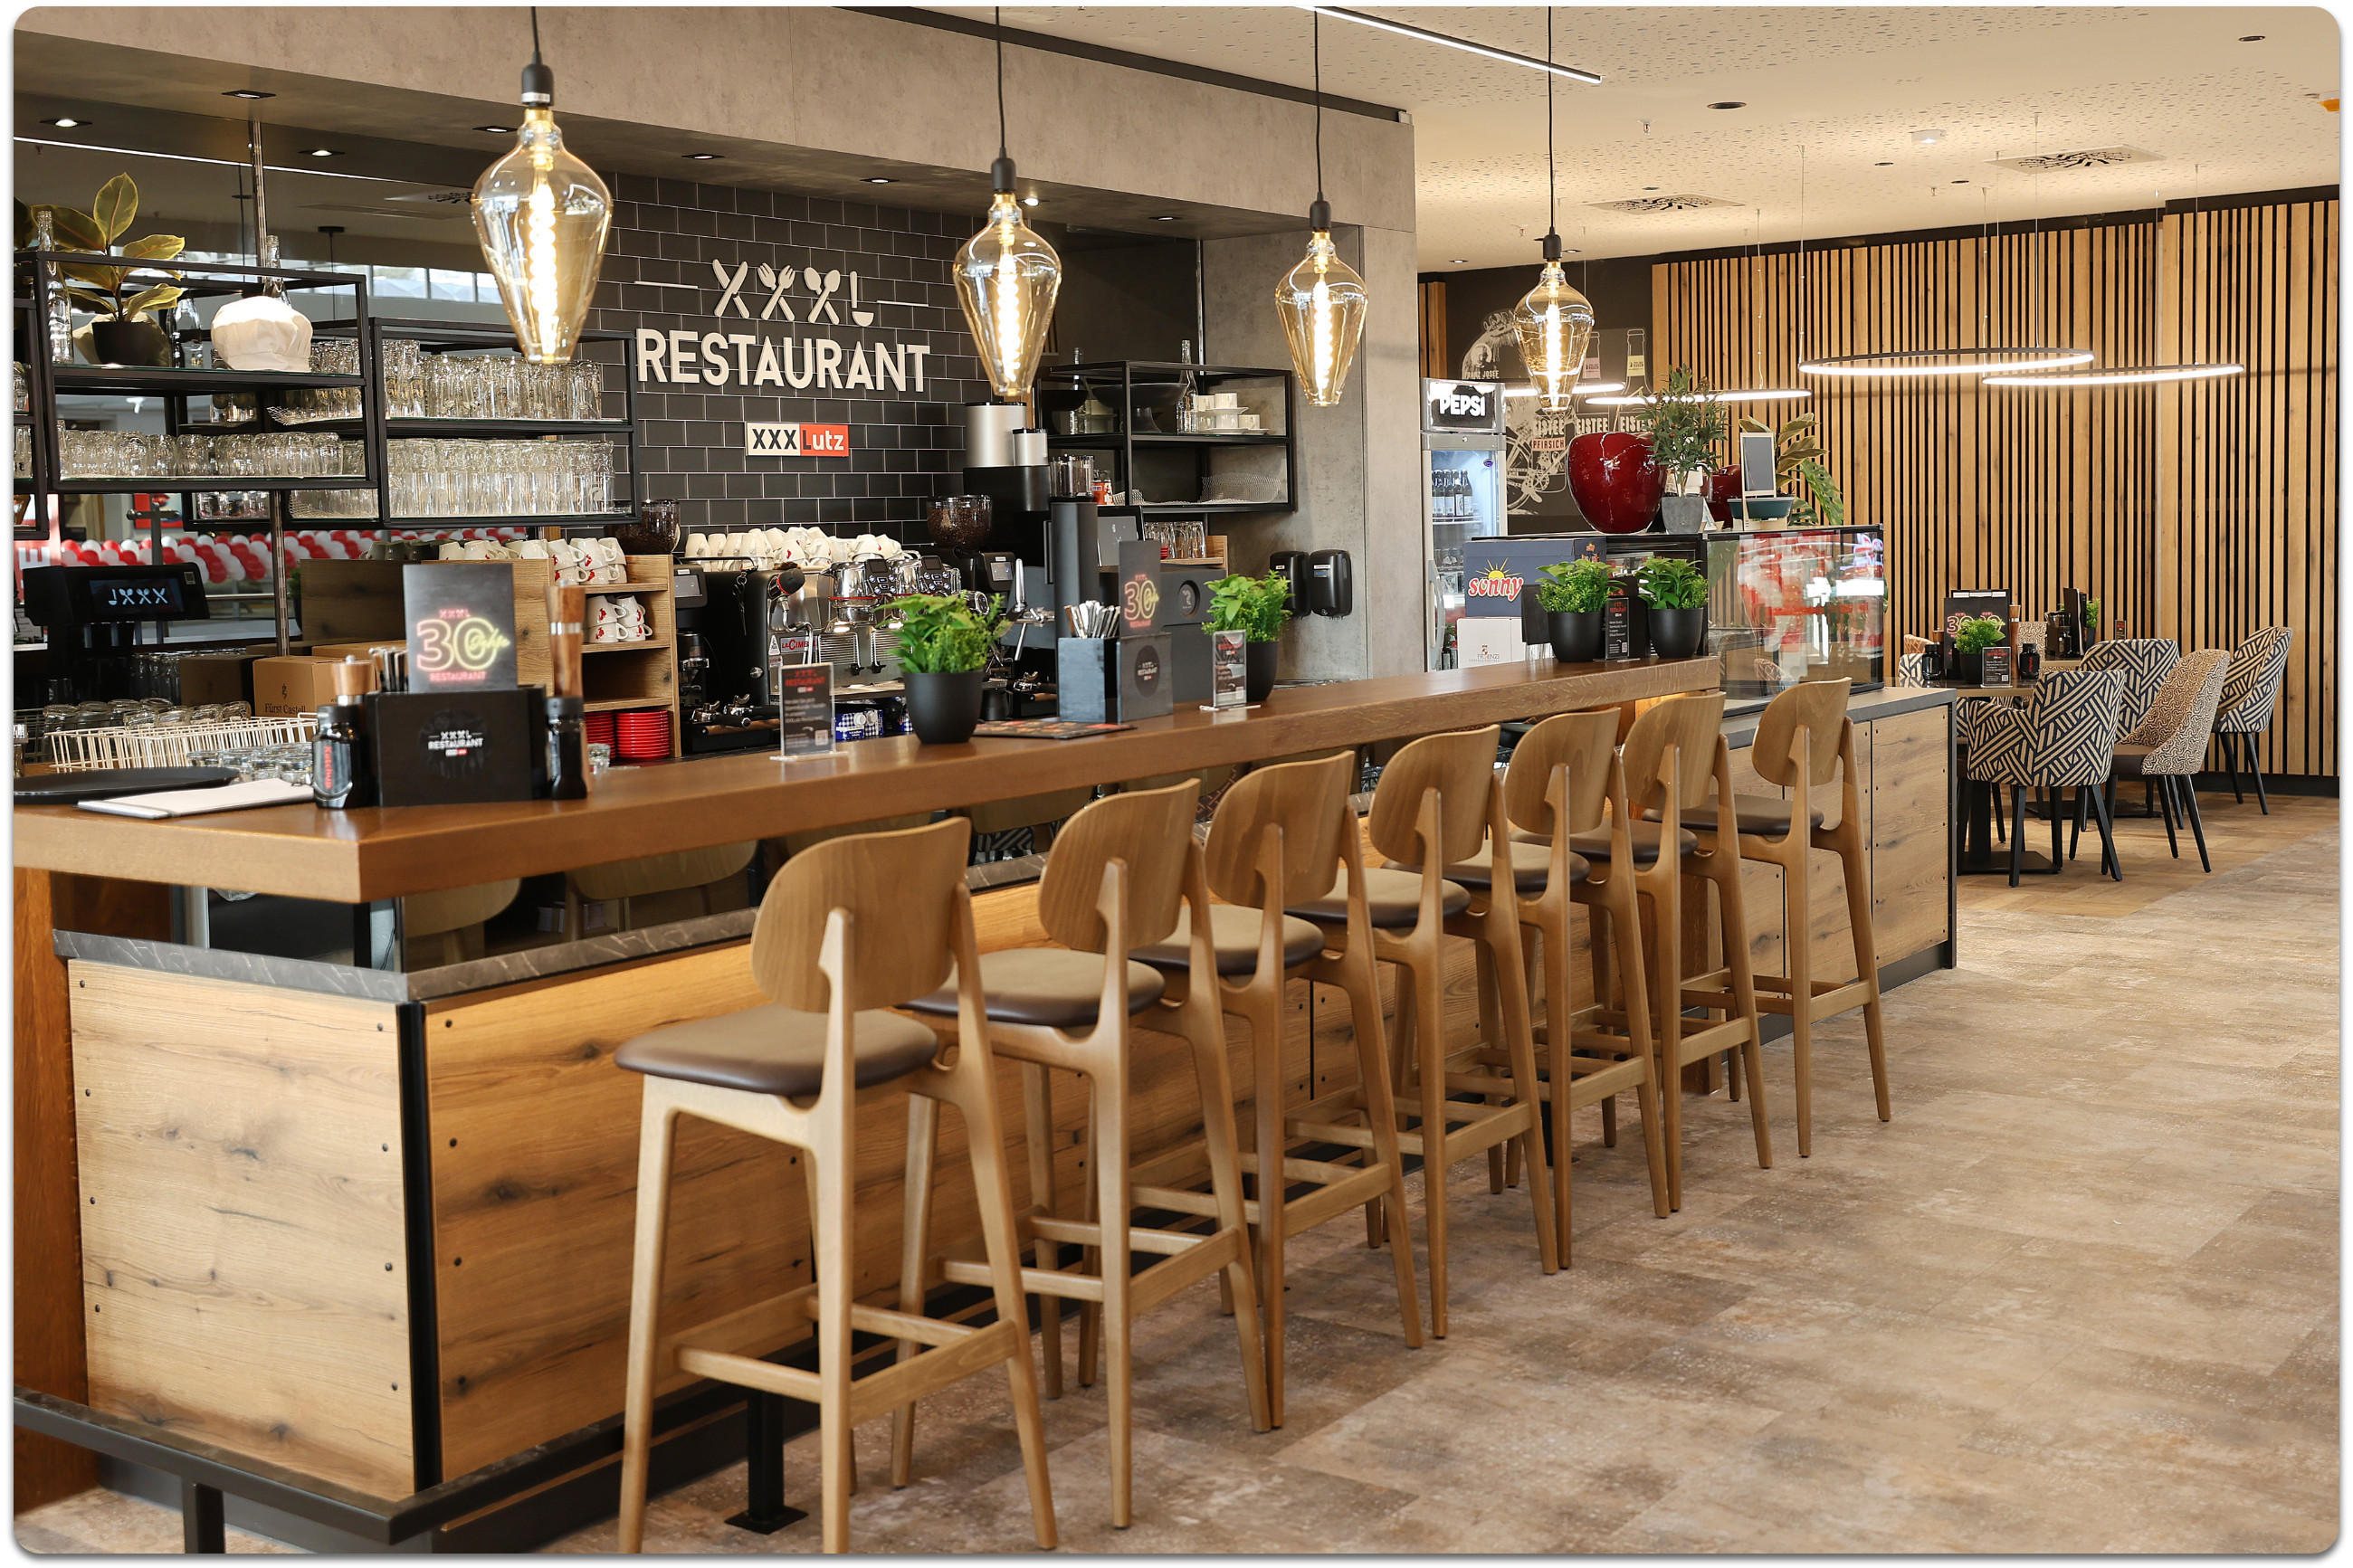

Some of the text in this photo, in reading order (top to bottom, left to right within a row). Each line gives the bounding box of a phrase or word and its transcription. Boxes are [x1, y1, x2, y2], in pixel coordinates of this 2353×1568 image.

[636, 328, 930, 393] RESTAURANT
[1439, 394, 1486, 417] PEPSI
[1577, 417, 1609, 433] EISTEE
[1532, 439, 1565, 450] PFIRSICH
[1124, 579, 1157, 621] 30
[1468, 577, 1524, 602] sonny
[416, 617, 498, 671] 30
[429, 670, 487, 681] RESTAURANT
[428, 737, 483, 750] RESTAURANT
[324, 746, 333, 789] Ketchup
